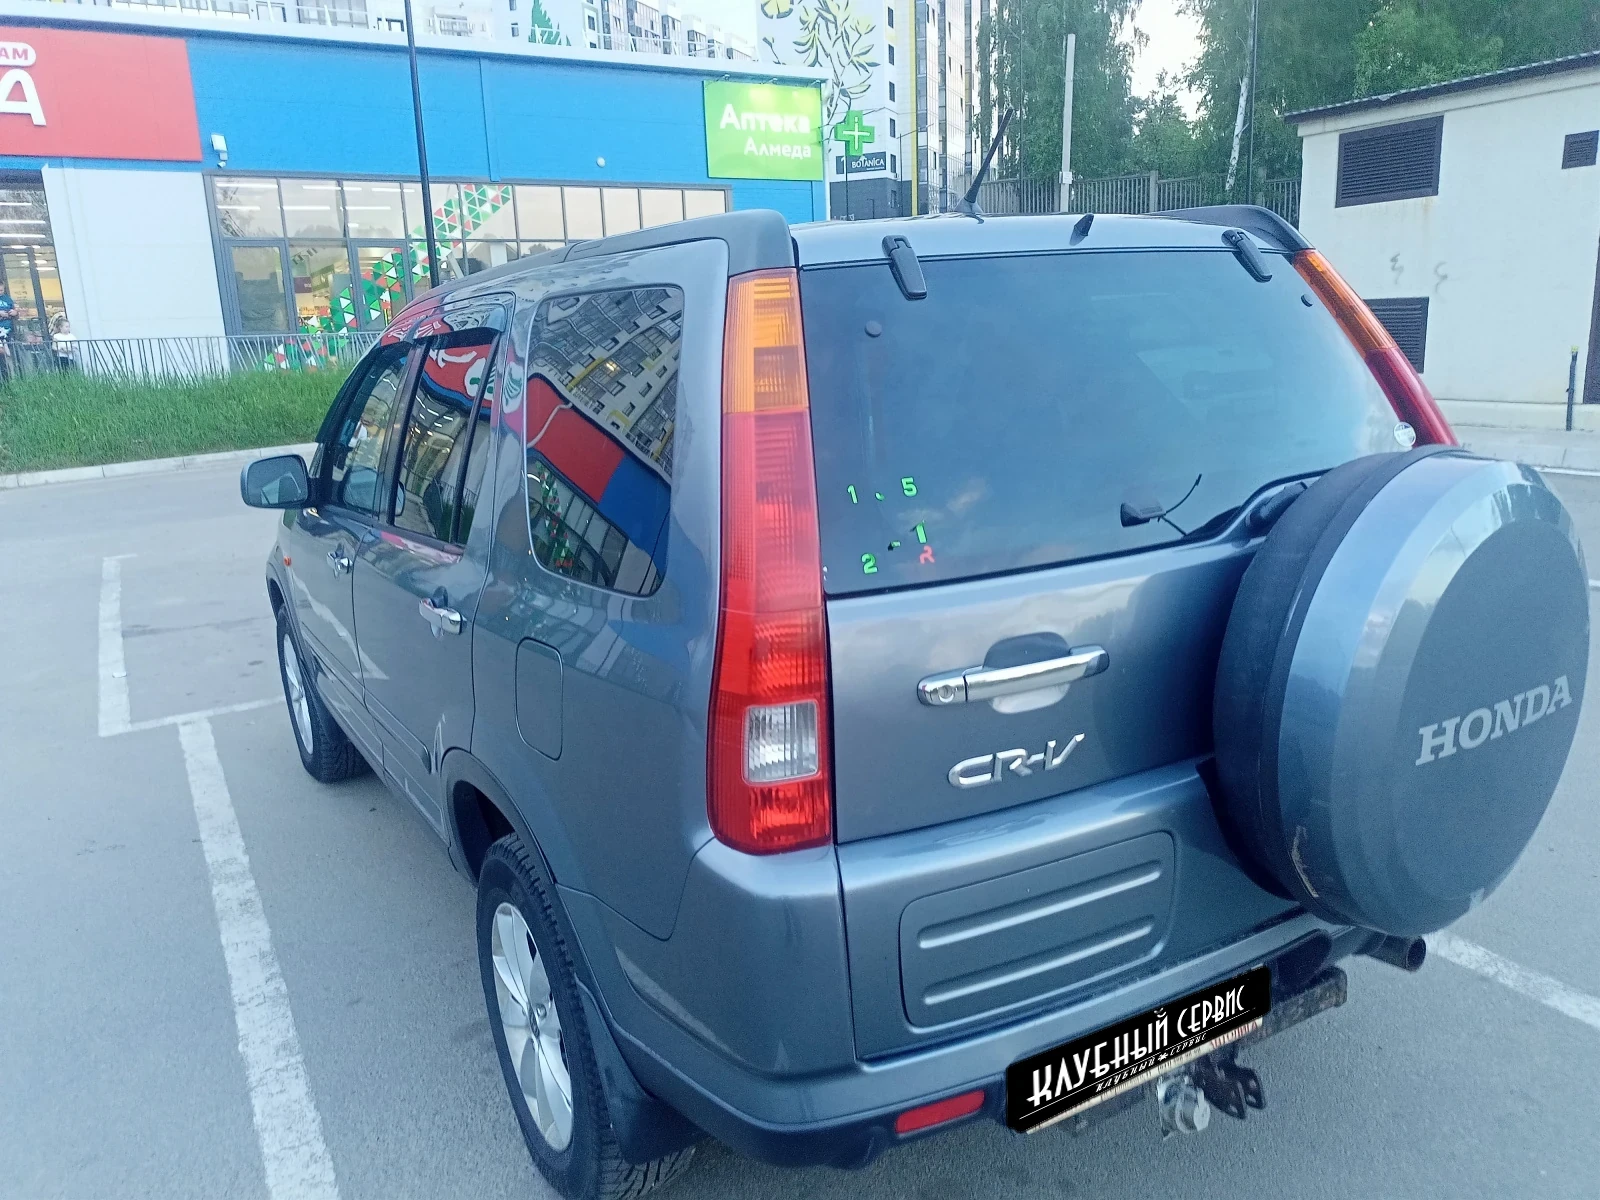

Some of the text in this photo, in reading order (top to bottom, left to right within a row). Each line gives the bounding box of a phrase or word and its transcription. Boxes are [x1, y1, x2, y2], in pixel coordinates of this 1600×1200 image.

[720, 103, 811, 134] Аптека
[744, 137, 811, 159] Алмеда
[851, 157, 885, 169] BOTANICA
[1415, 674, 1572, 766] HONDA
[947, 732, 1085, 789] CR-V
